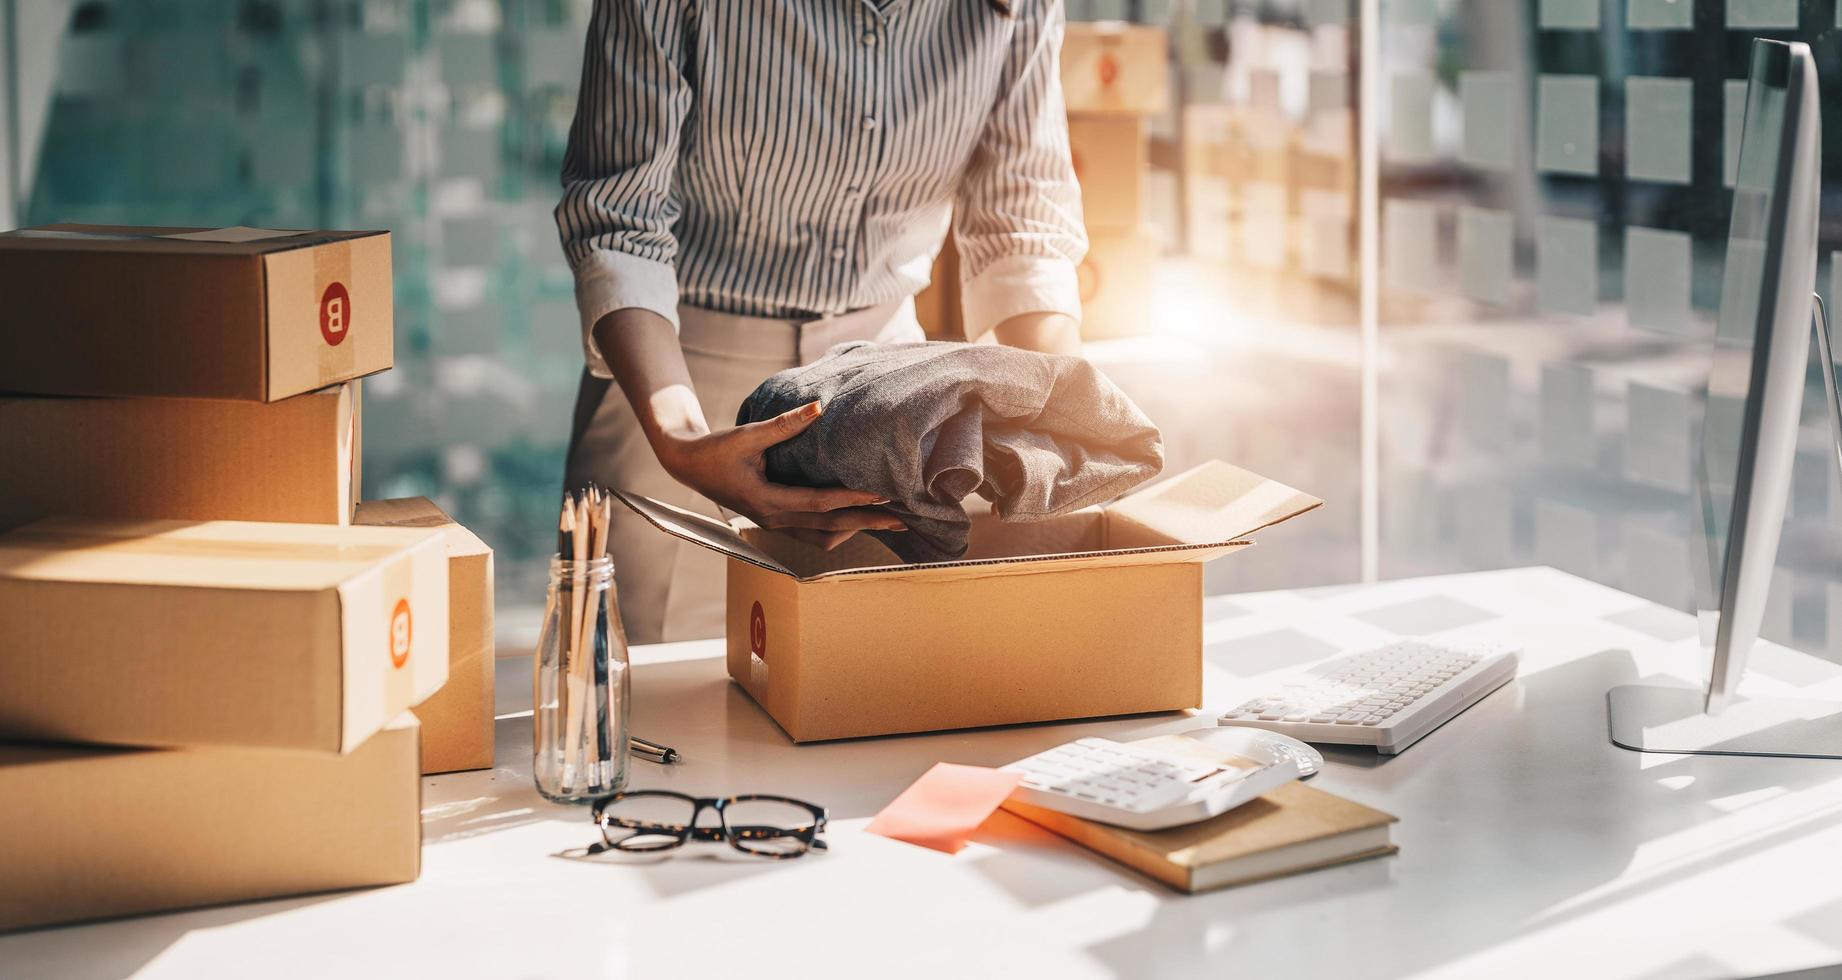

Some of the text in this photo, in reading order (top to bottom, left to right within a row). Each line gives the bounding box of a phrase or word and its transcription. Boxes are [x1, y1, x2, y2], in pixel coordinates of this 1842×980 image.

[327, 297, 343, 333] B
[393, 612, 408, 656] B
[755, 616, 762, 649] C
